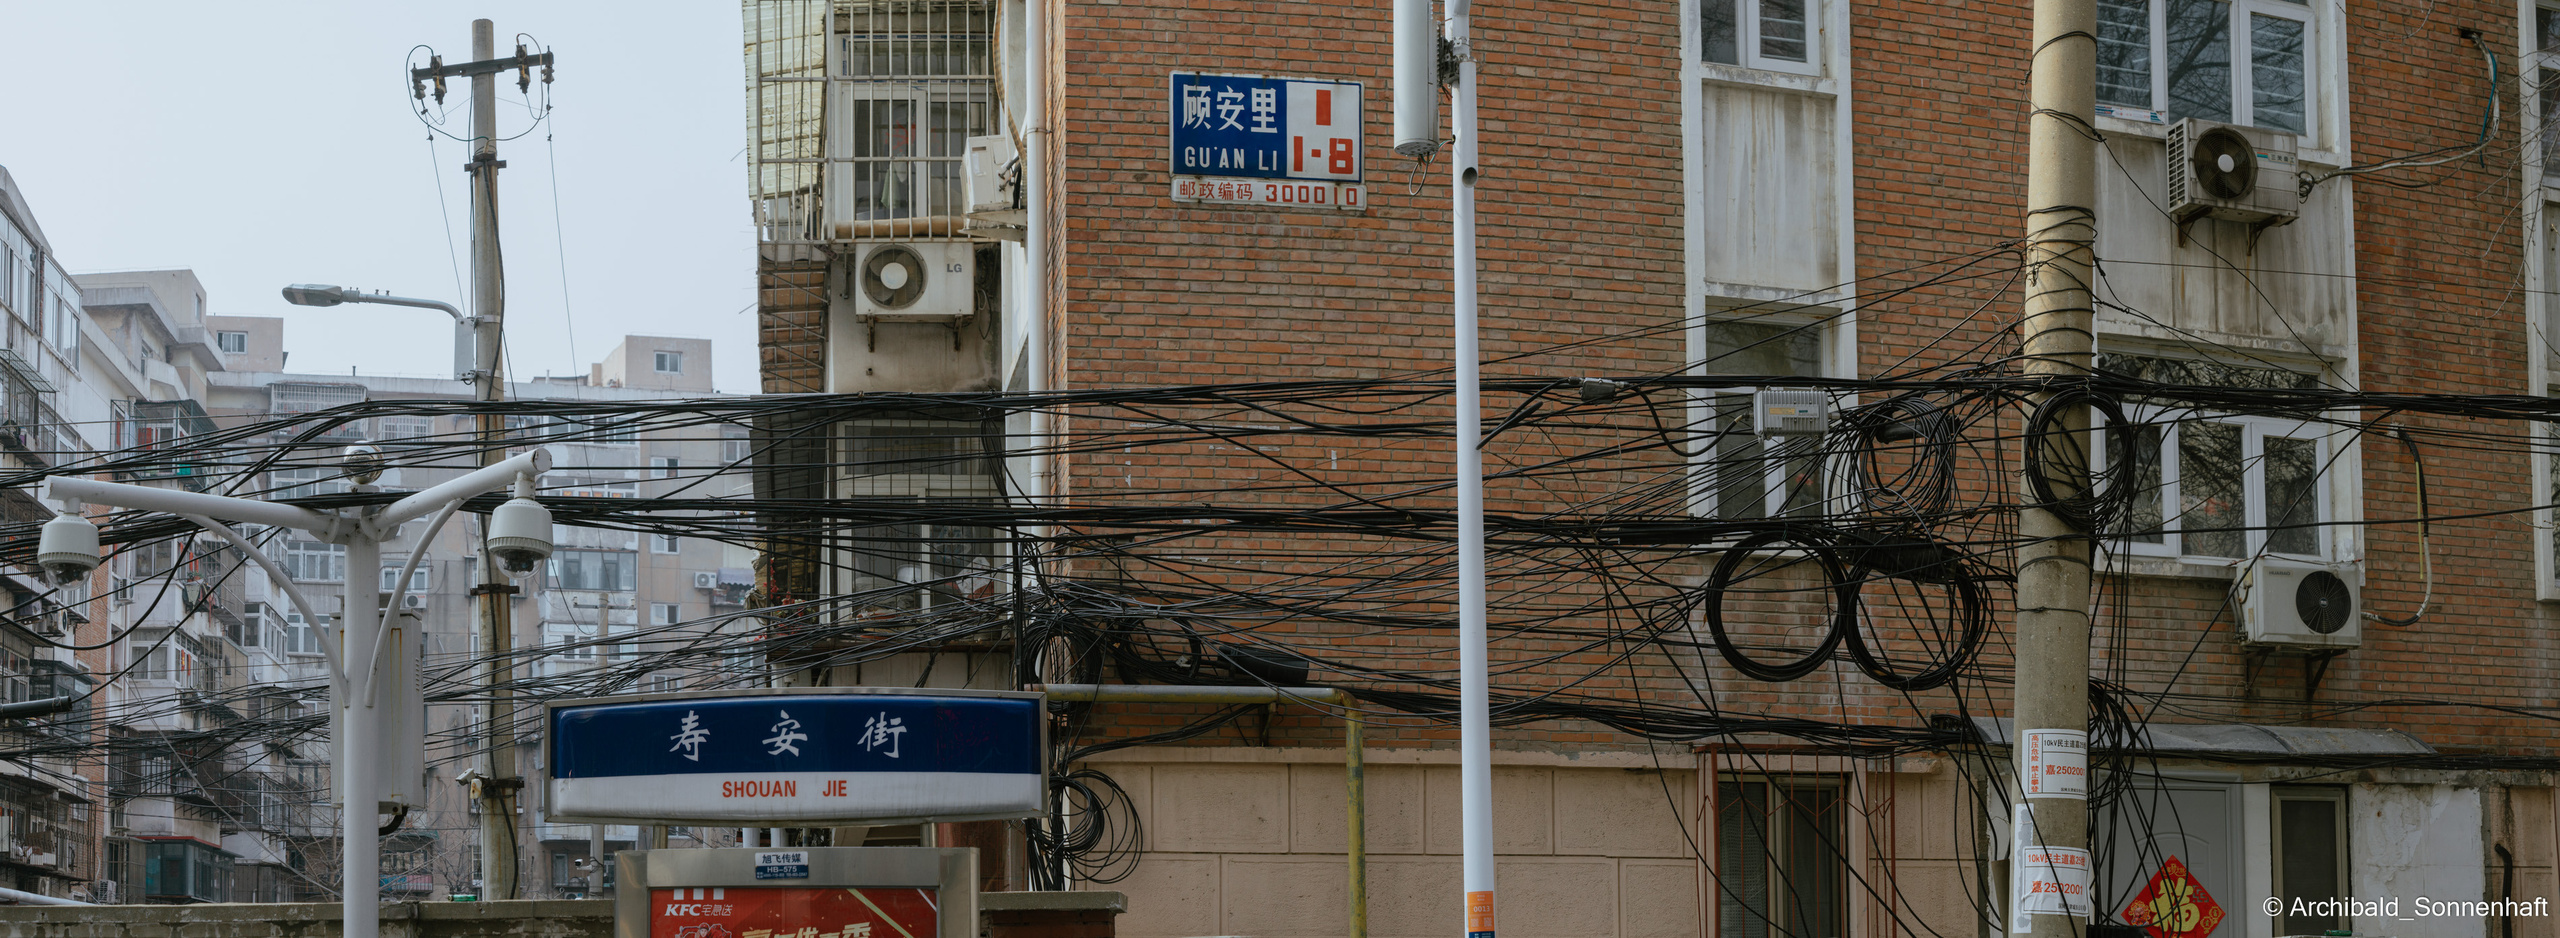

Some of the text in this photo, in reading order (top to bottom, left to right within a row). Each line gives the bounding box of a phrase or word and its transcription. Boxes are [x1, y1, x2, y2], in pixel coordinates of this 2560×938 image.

[1182, 84, 1278, 134] 顾安里
[1258, 150, 1277, 171] LI
[1293, 136, 1354, 174] 1-8
[1179, 180, 1357, 206] 邮政编码 300010
[946, 263, 963, 273] LG
[669, 709, 908, 762] 寿安街
[2031, 734, 2039, 762] 高压危险
[722, 779, 848, 798] SHOUAN JIE
[762, 853, 802, 864] 旭飞传媒
[664, 904, 733, 917] KFC 宅急送
[1473, 905, 1490, 913] 0013
[2149, 877, 2200, 932] 福
